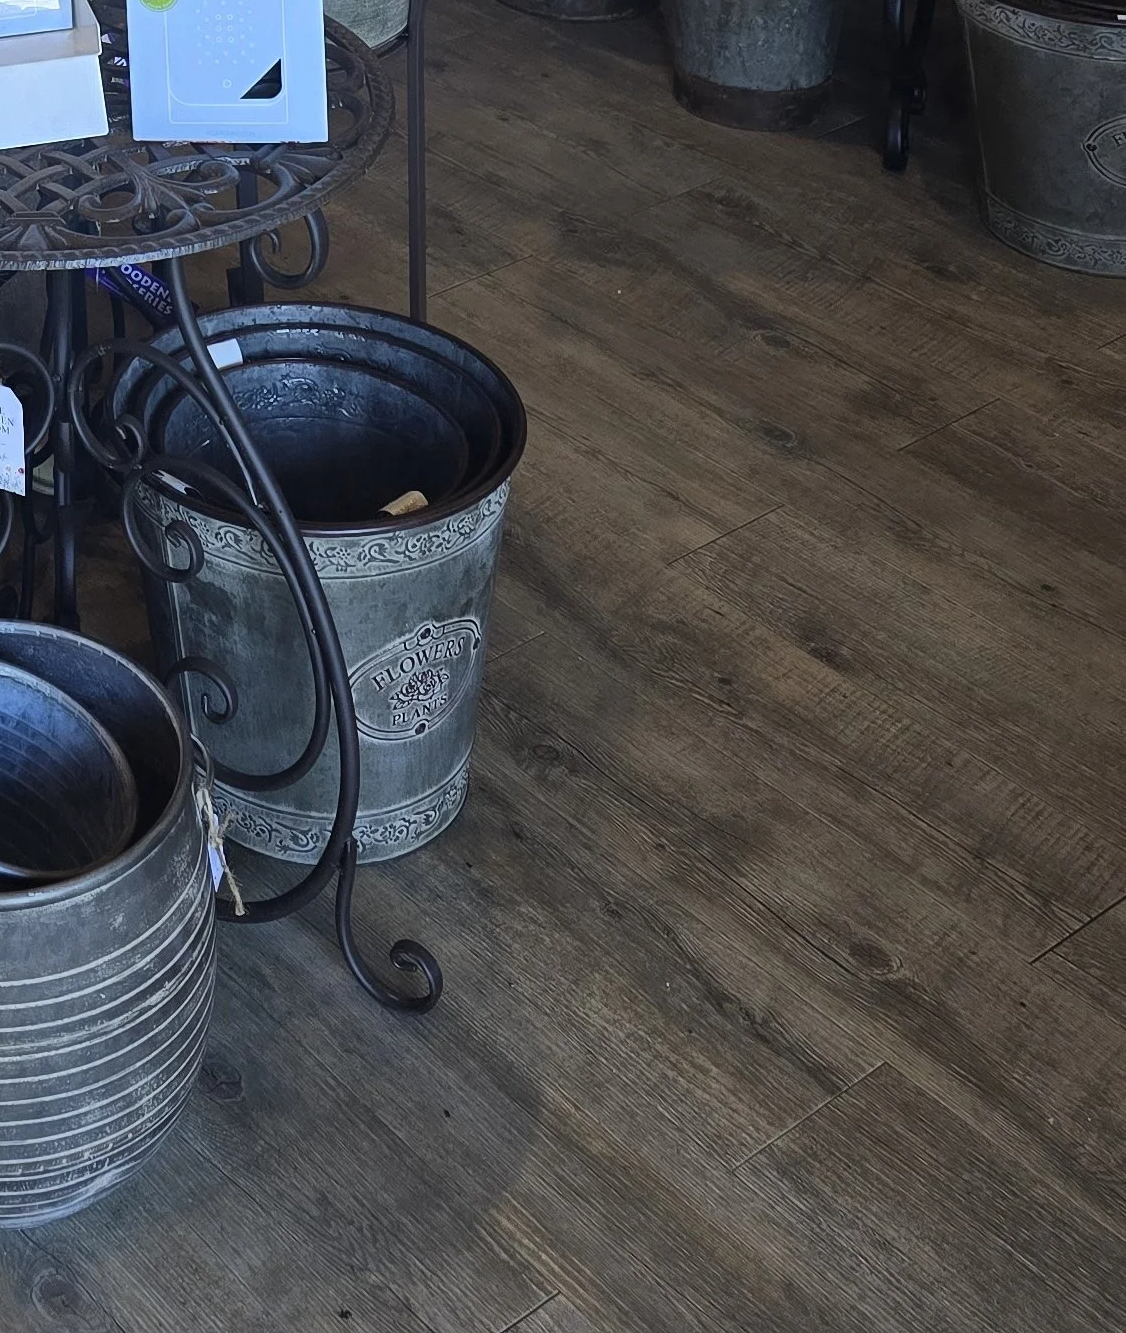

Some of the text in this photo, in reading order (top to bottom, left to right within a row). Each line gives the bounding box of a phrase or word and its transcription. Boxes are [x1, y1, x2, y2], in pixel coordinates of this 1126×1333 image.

[120, 264, 171, 302] OODEN
[371, 636, 465, 692] FLOWERS
[392, 694, 448, 726] PLANTS
